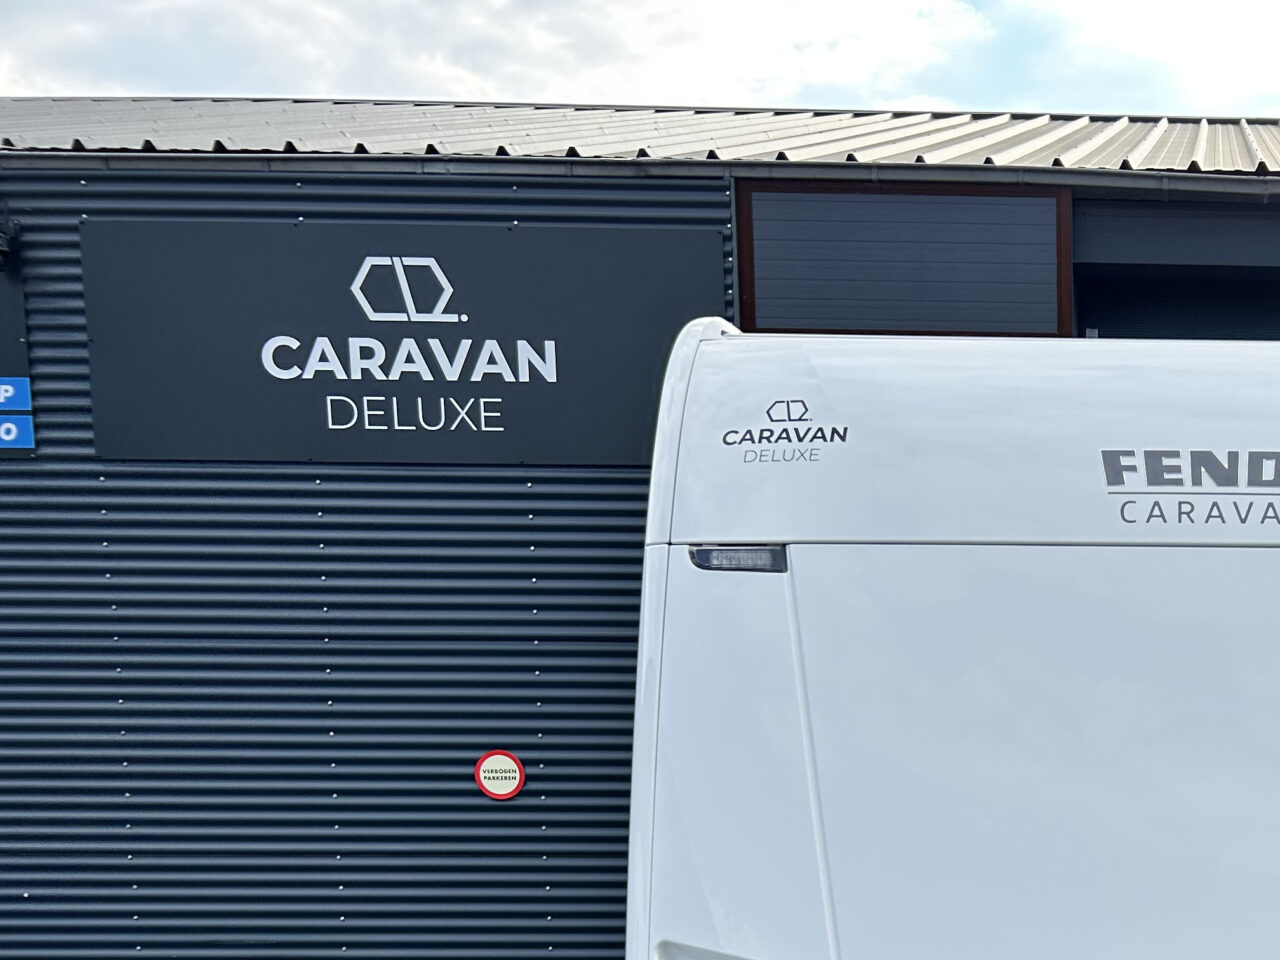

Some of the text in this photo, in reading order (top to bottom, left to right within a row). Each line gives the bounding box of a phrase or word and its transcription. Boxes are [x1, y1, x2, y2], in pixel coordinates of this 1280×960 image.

[261, 335, 557, 383] CARAVAN
[326, 395, 504, 431] DELUXE
[722, 426, 848, 446] CARAVAN
[743, 448, 821, 463] DELUXE
